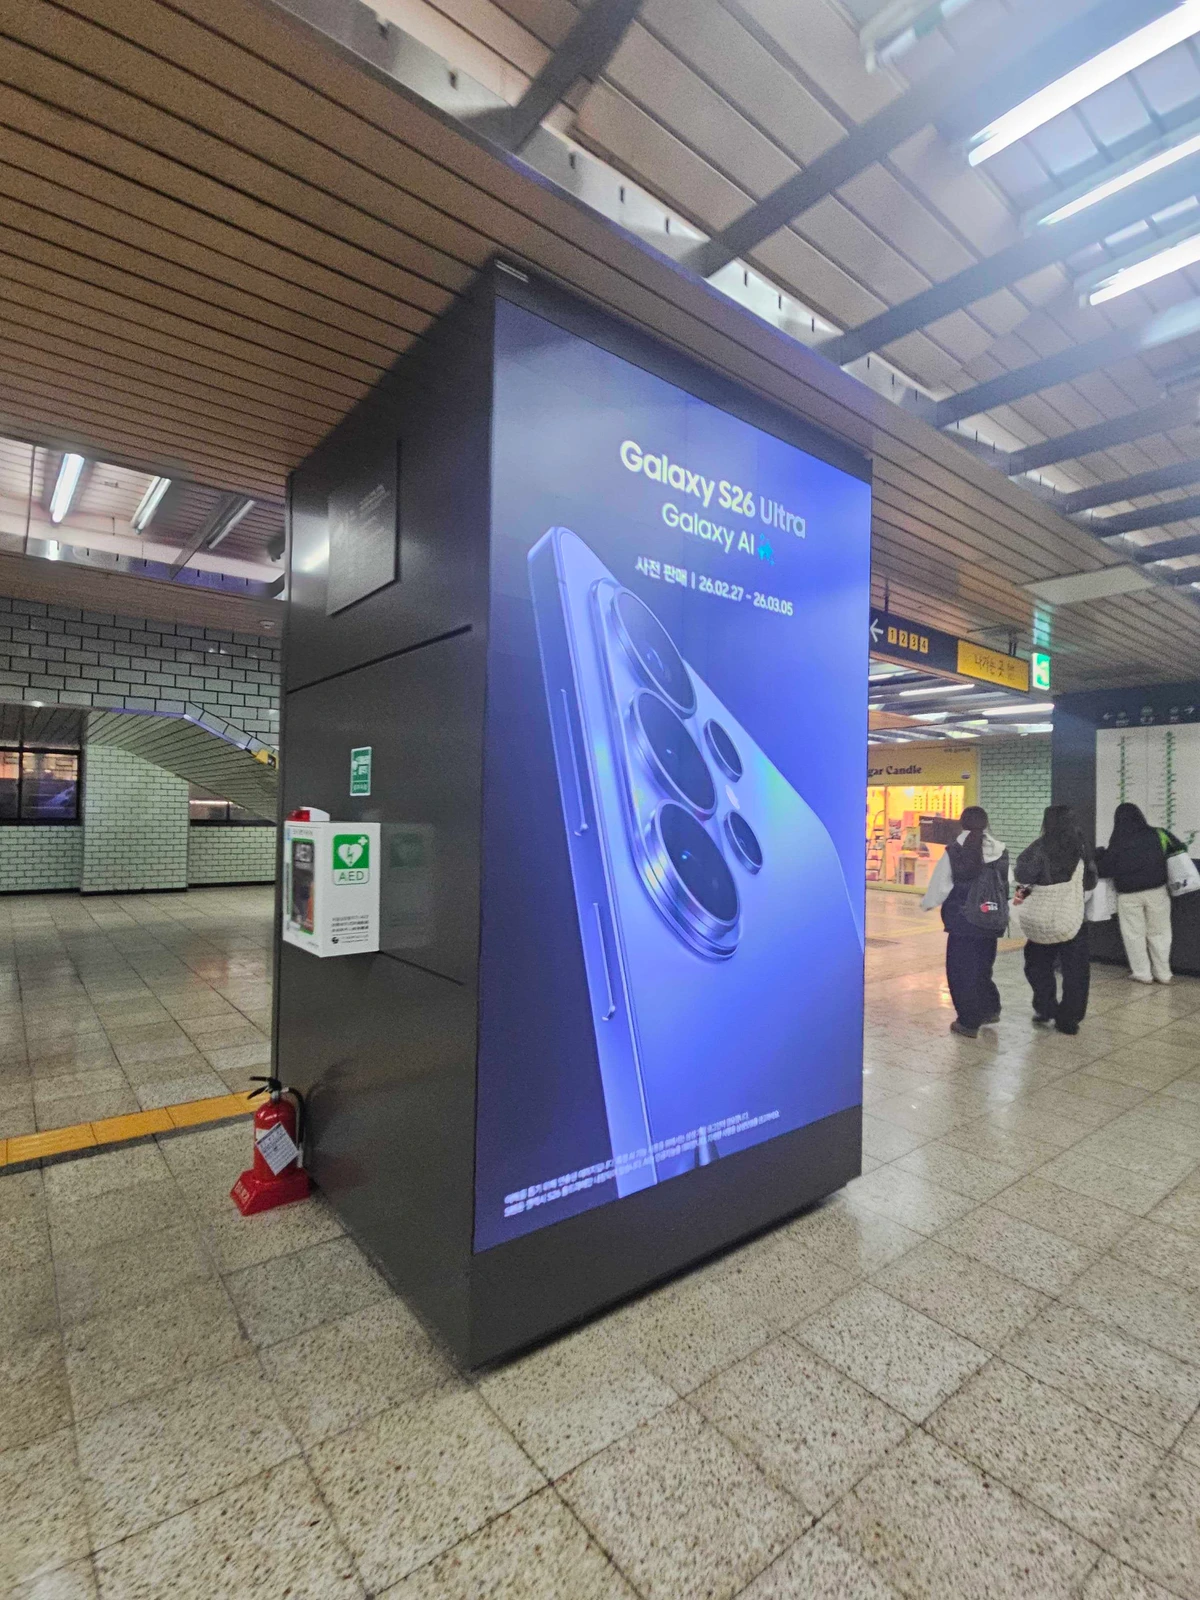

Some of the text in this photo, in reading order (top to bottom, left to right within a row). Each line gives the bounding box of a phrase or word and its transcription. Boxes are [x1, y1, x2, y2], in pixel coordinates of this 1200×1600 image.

[620, 440, 807, 540] Galaxy S26 Ultra
[661, 502, 755, 556] Galaxy AI
[635, 556, 661, 580] 사전
[663, 563, 688, 588] 판매
[698, 575, 745, 602] 26.02.27
[753, 591, 794, 617] 26.03.05
[885, 765, 922, 776] Candle
[338, 870, 365, 882] AED
